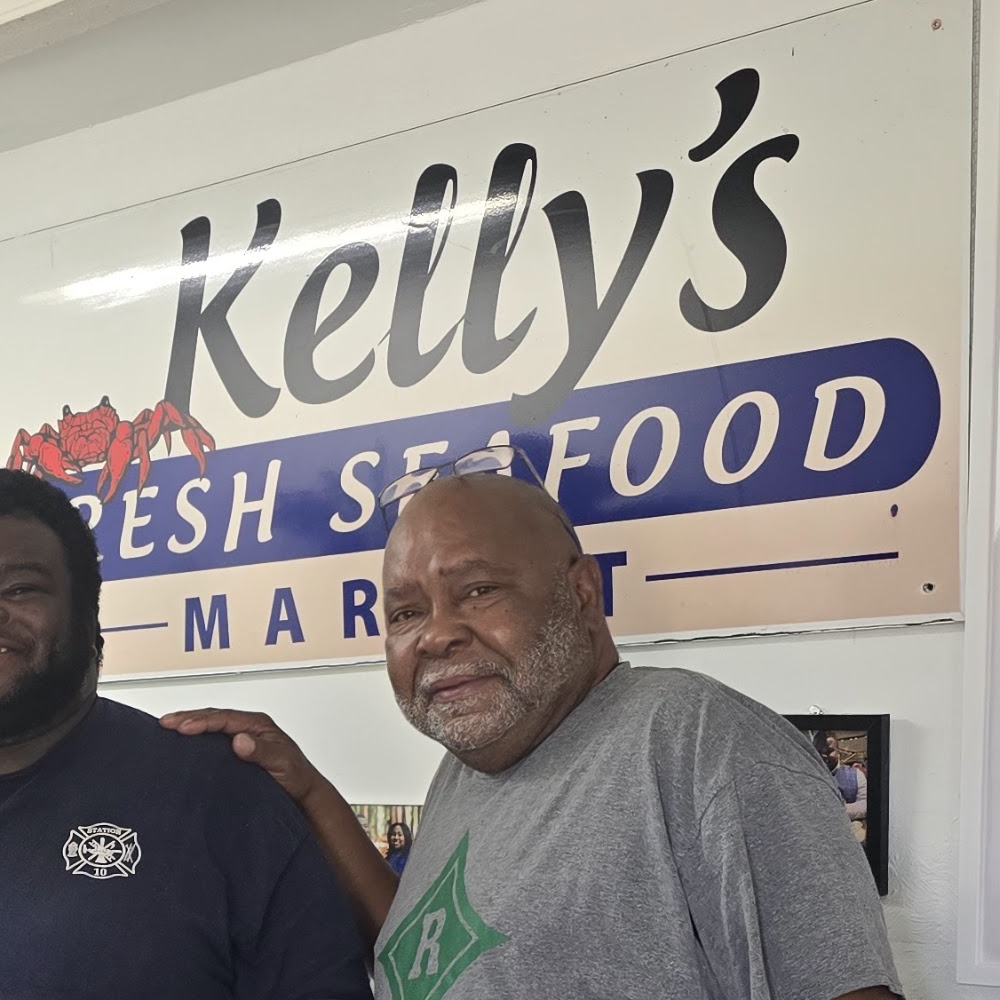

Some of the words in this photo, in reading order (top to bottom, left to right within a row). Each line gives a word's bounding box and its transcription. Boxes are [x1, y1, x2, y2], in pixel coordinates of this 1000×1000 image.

[163, 68, 800, 427] Kelly's
[184, 551, 627, 652] MART
[86, 827, 122, 836] STATION
[93, 868, 107, 876] 10
[407, 907, 447, 981] R
